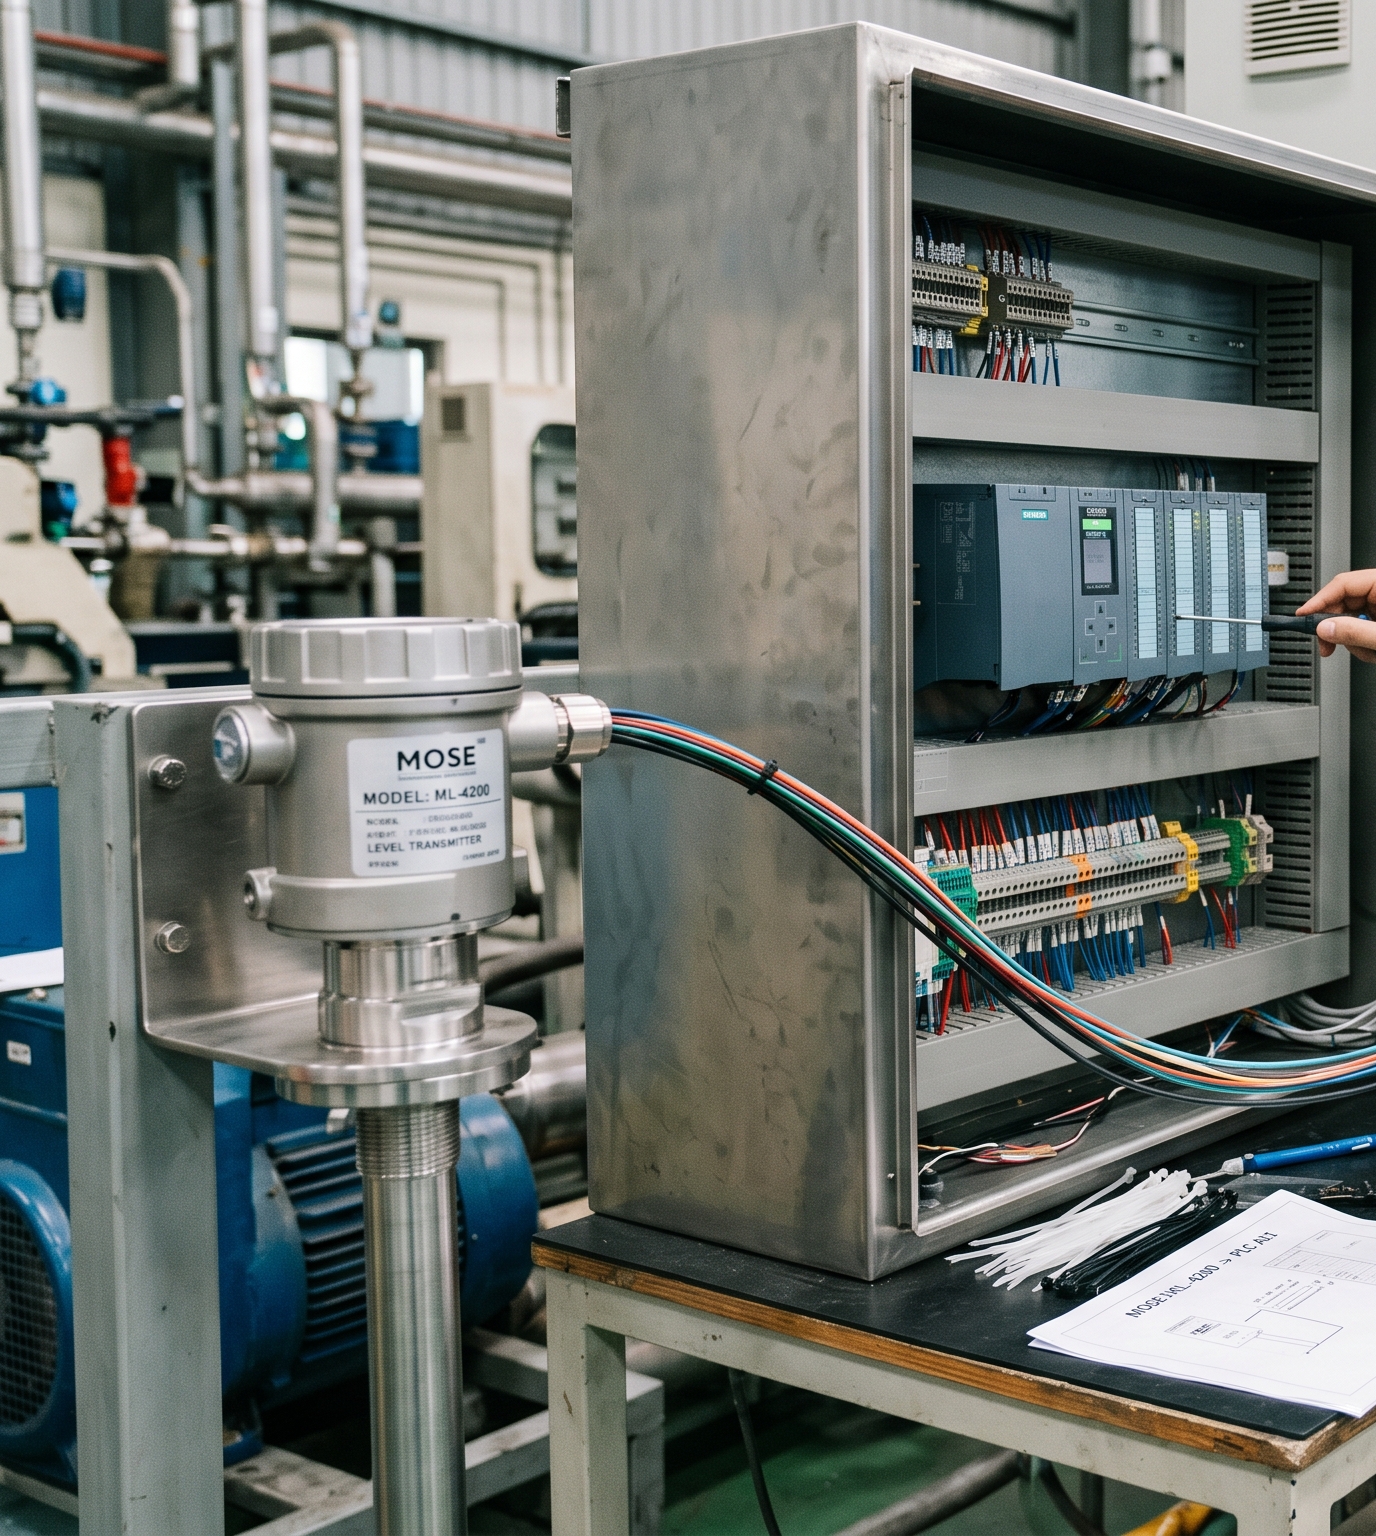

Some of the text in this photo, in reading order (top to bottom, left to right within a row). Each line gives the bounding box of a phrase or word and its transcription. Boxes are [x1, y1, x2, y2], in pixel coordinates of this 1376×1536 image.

[397, 745, 476, 771] MOSE
[363, 783, 490, 805] MODEL: ML-4200
[367, 842, 405, 853] LEVEL
[409, 834, 482, 851] TRANSMITTER
